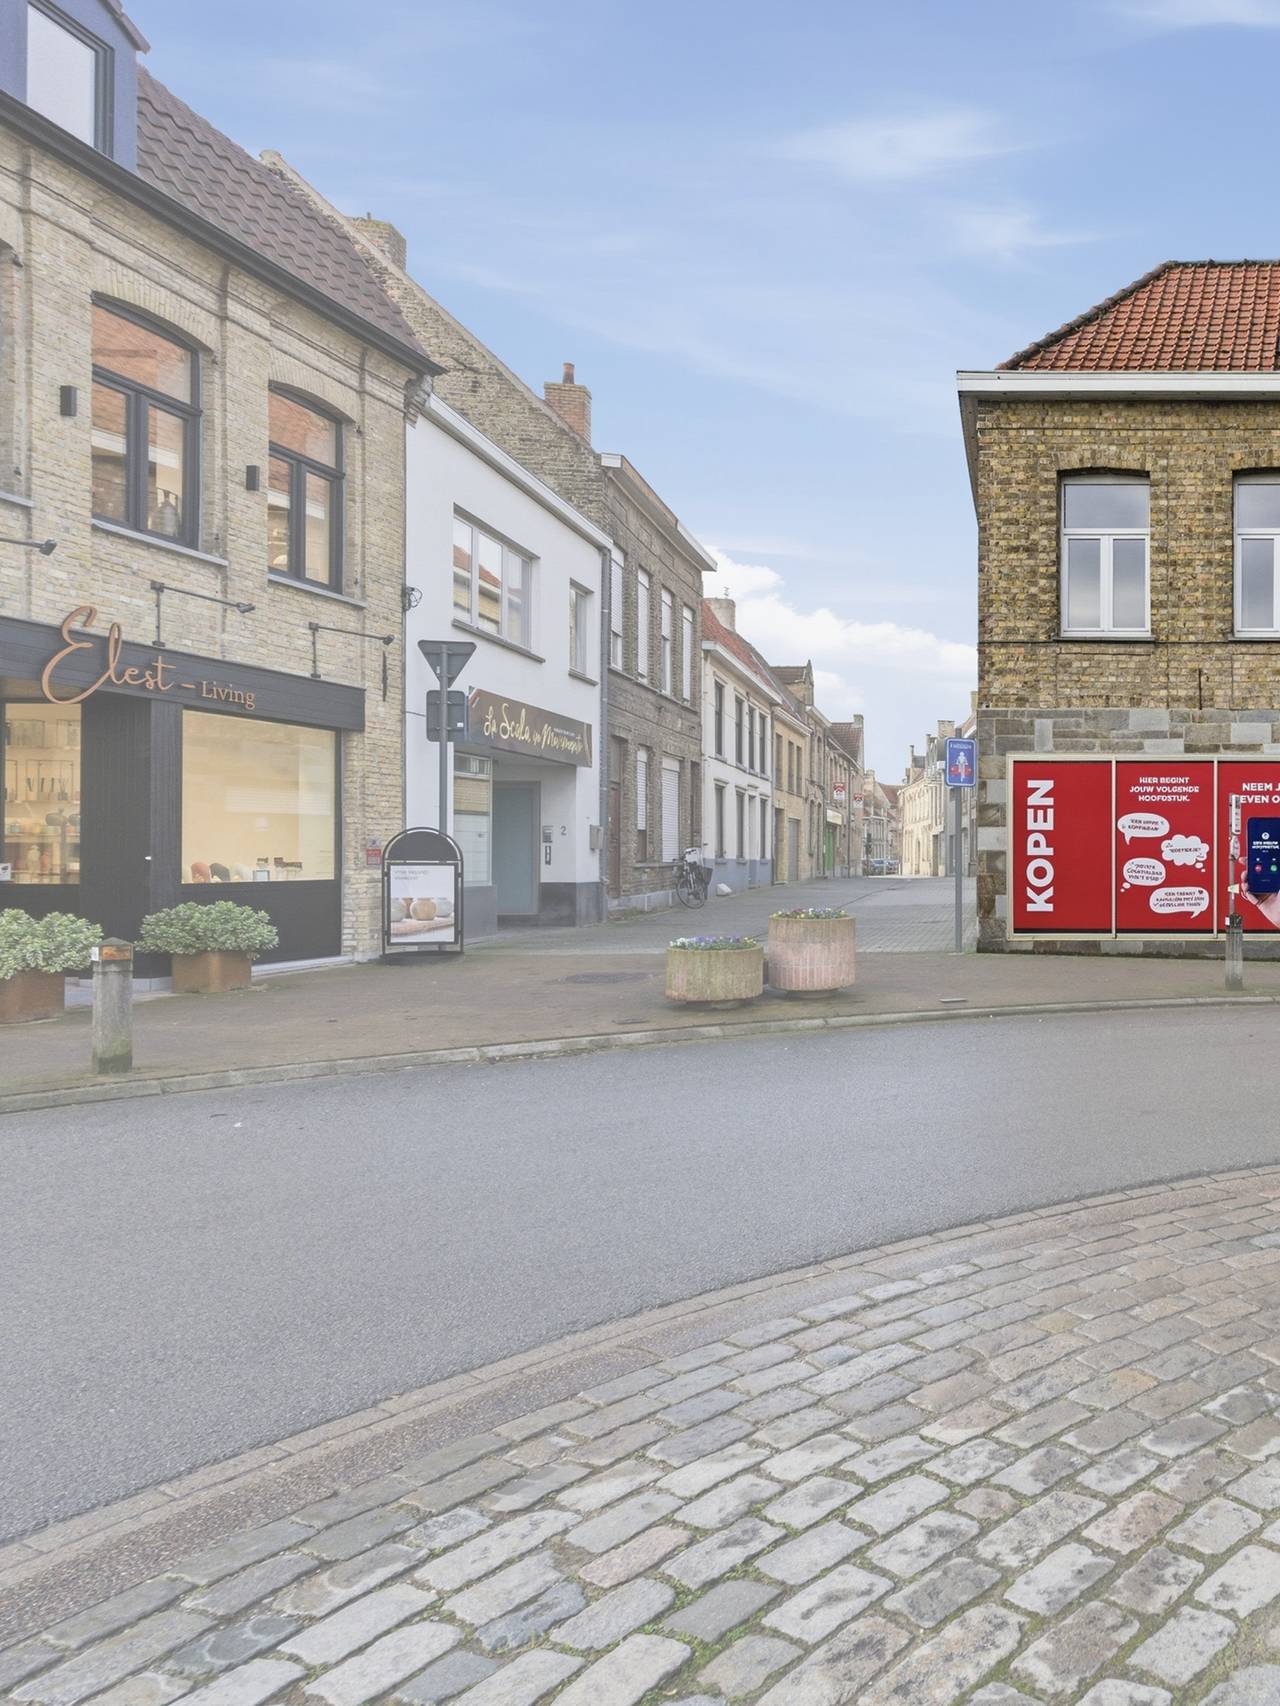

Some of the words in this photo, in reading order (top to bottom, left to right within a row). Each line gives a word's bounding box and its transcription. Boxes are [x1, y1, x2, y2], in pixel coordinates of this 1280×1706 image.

[42, 606, 176, 704] Elest
[201, 680, 256, 710] Living
[1139, 776, 1159, 784] HIER
[1160, 776, 1190, 784] BEGINT
[1242, 782, 1273, 792] NEEM
[1138, 794, 1191, 802] HOOFDSTUK.
[1240, 795, 1270, 804] EVEN
[560, 825, 567, 836] 2
[1026, 779, 1055, 912] KOPEN
